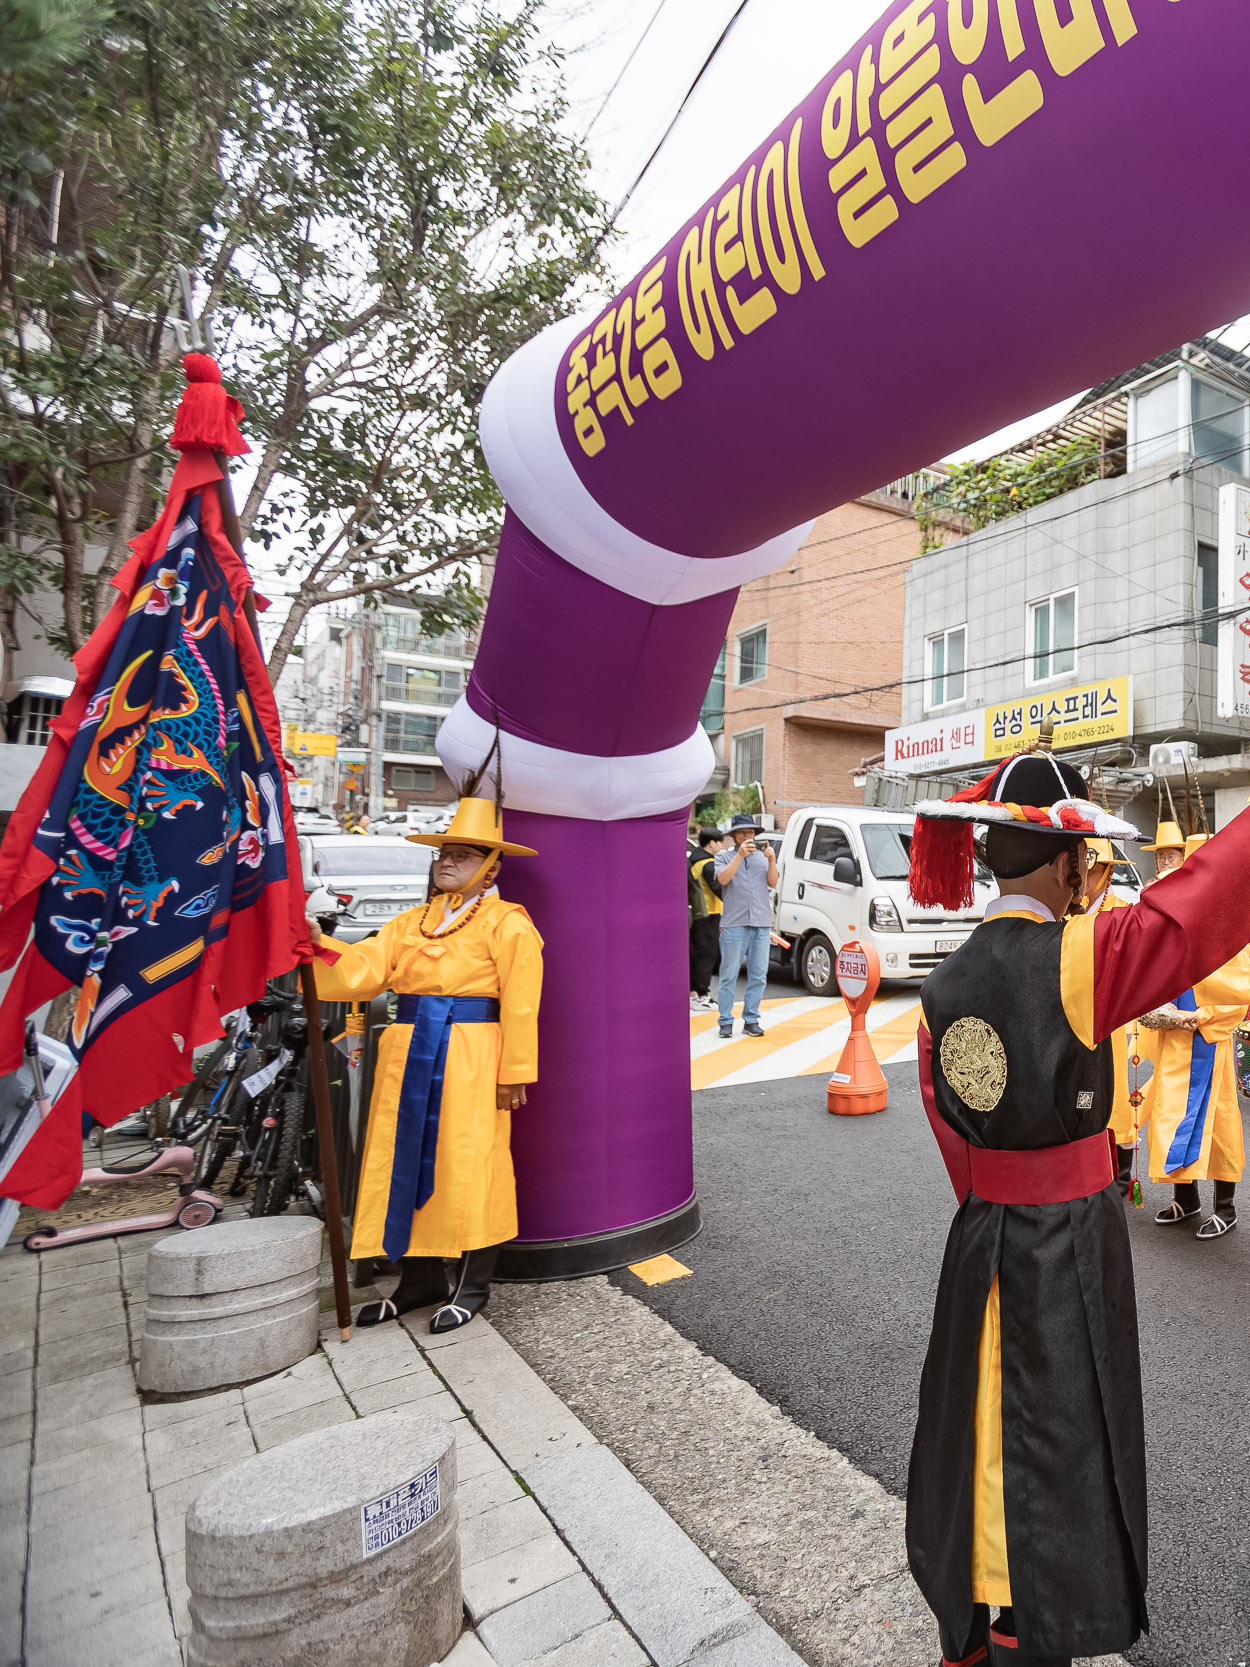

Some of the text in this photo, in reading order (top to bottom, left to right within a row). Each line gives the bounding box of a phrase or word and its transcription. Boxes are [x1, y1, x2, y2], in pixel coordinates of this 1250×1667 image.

[567, 256, 682, 457] 중곡2동
[678, 124, 825, 360] 어린이
[993, 687, 1118, 739] 삼성 익스프레스
[1063, 724, 1115, 741] 010-4765-2224
[893, 723, 976, 761] Rinnai 센터
